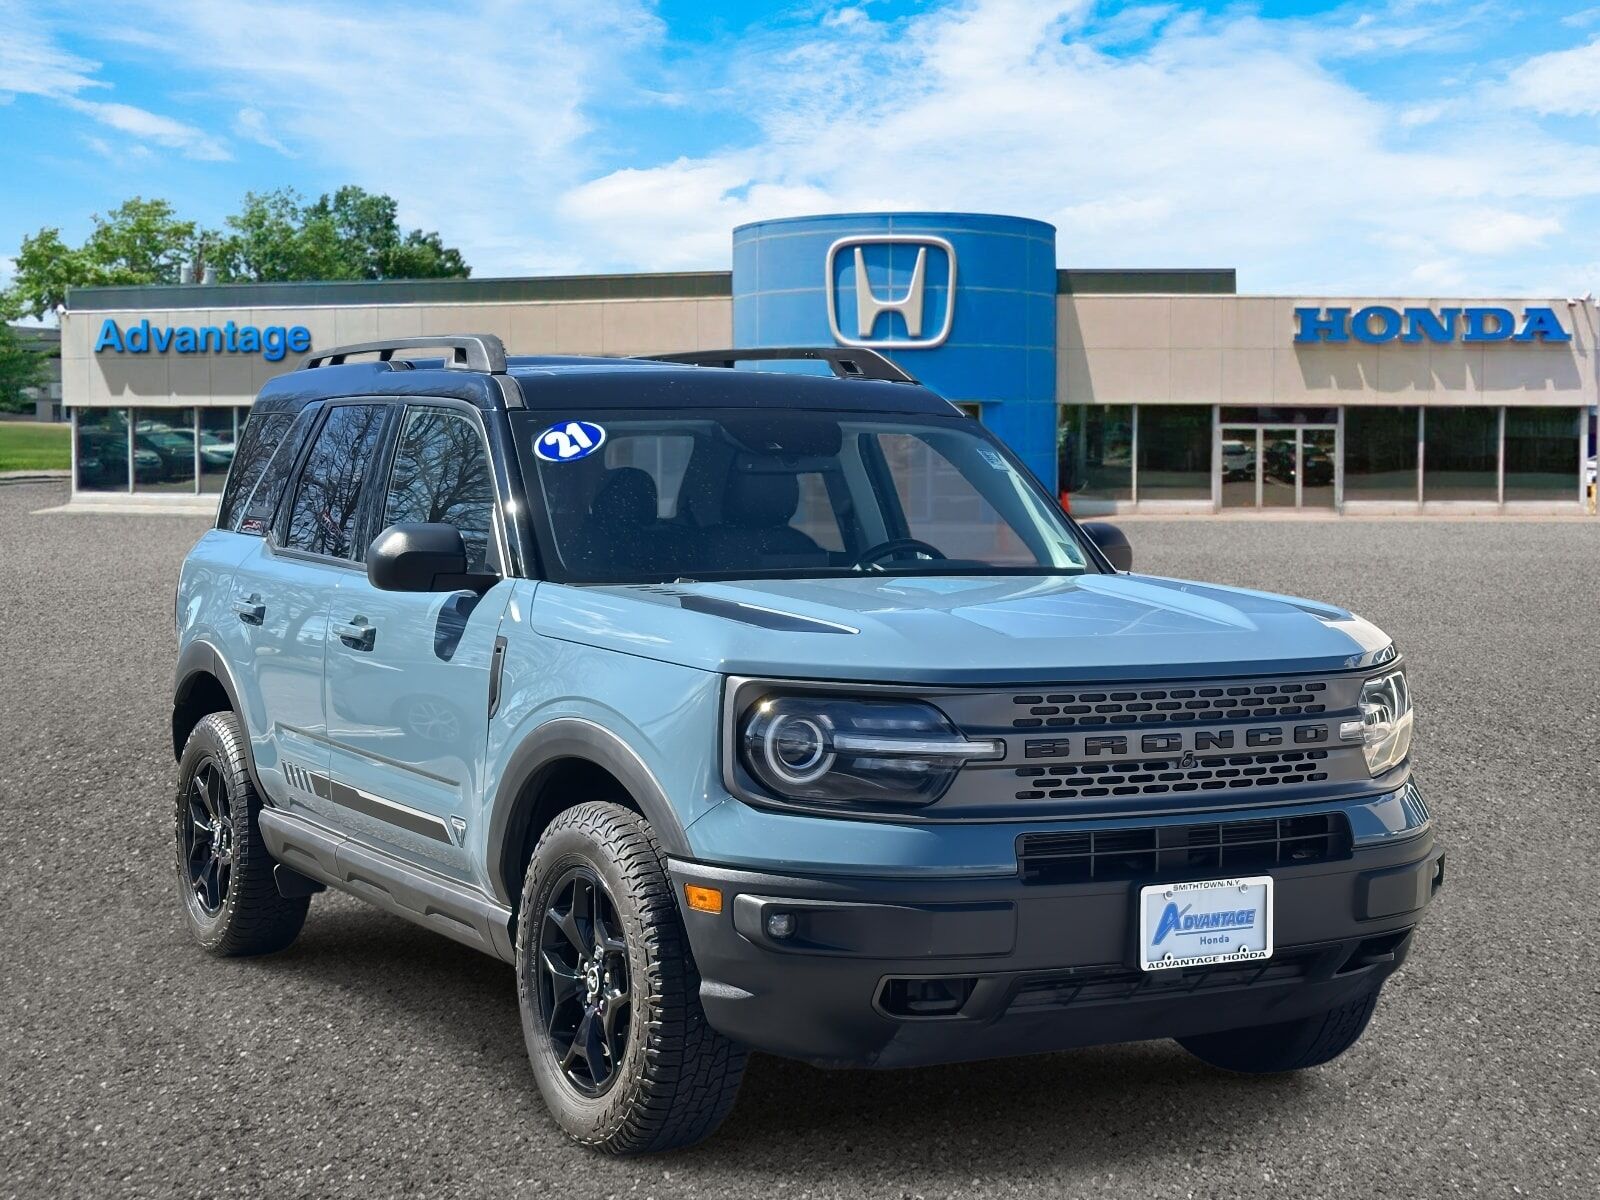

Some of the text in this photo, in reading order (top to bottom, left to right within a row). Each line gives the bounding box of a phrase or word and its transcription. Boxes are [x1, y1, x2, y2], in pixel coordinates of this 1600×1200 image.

[95, 318, 311, 361] Advantage
[1294, 306, 1572, 344] HONDA
[545, 422, 592, 457] 21
[1025, 724, 1328, 758] BRONCO
[1151, 902, 1256, 946] ADVANTAGE
[1200, 934, 1230, 945] Honda
[1148, 952, 1266, 969] ADVANTAGE HONDA
